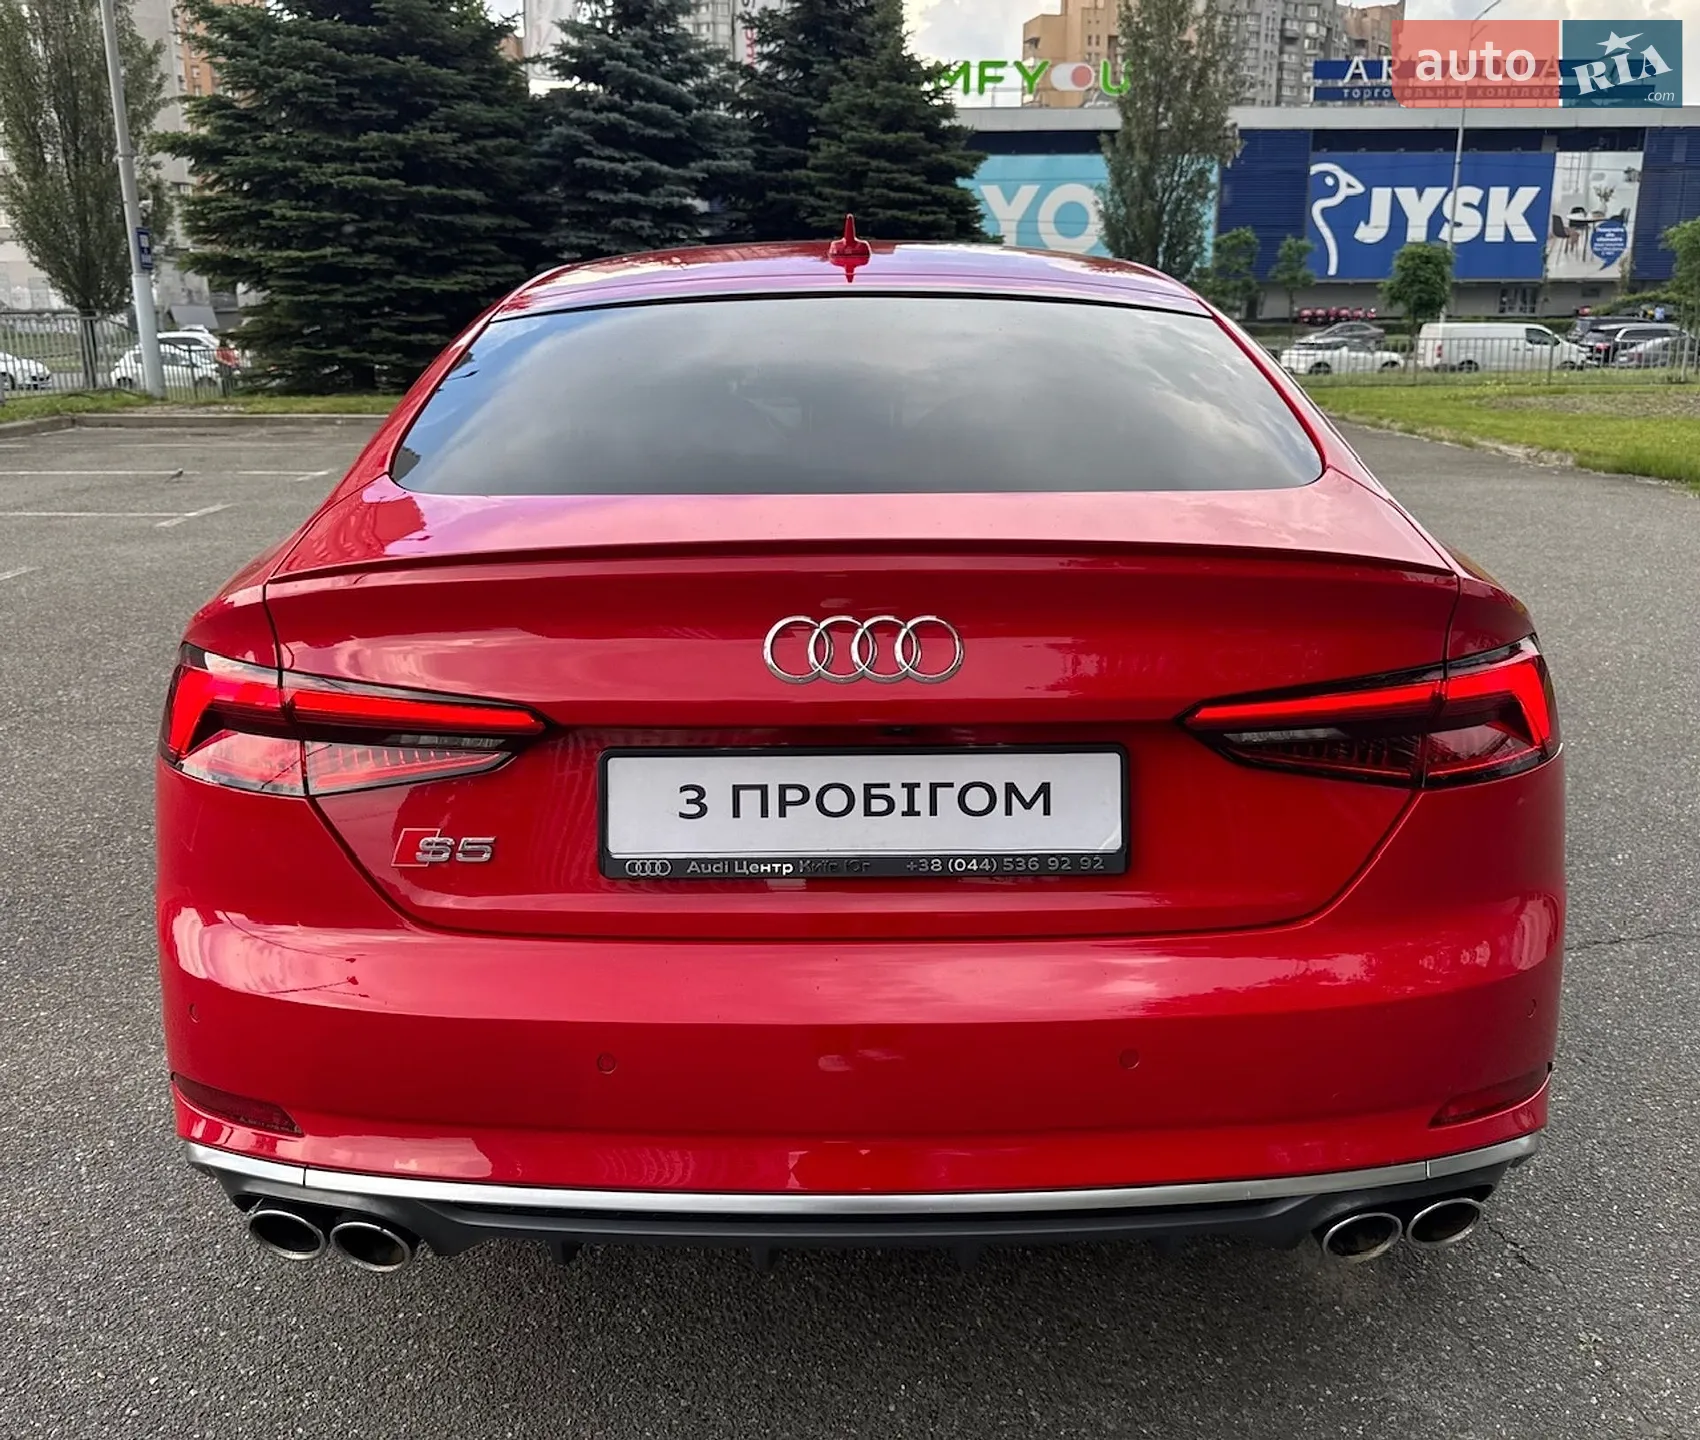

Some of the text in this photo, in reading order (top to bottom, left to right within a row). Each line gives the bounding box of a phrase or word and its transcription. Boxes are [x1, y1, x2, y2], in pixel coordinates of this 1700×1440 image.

[1353, 185, 1542, 244] JYSK
[731, 781, 1052, 819] ПРОБІГОМ
[415, 836, 497, 862] S5
[686, 860, 729, 874] Audi
[734, 860, 794, 876] Центр
[906, 858, 943, 872] +38
[948, 857, 998, 873] (044)
[1003, 857, 1040, 871] 536
[1047, 856, 1072, 870] 92
[1079, 856, 1105, 870] 92
